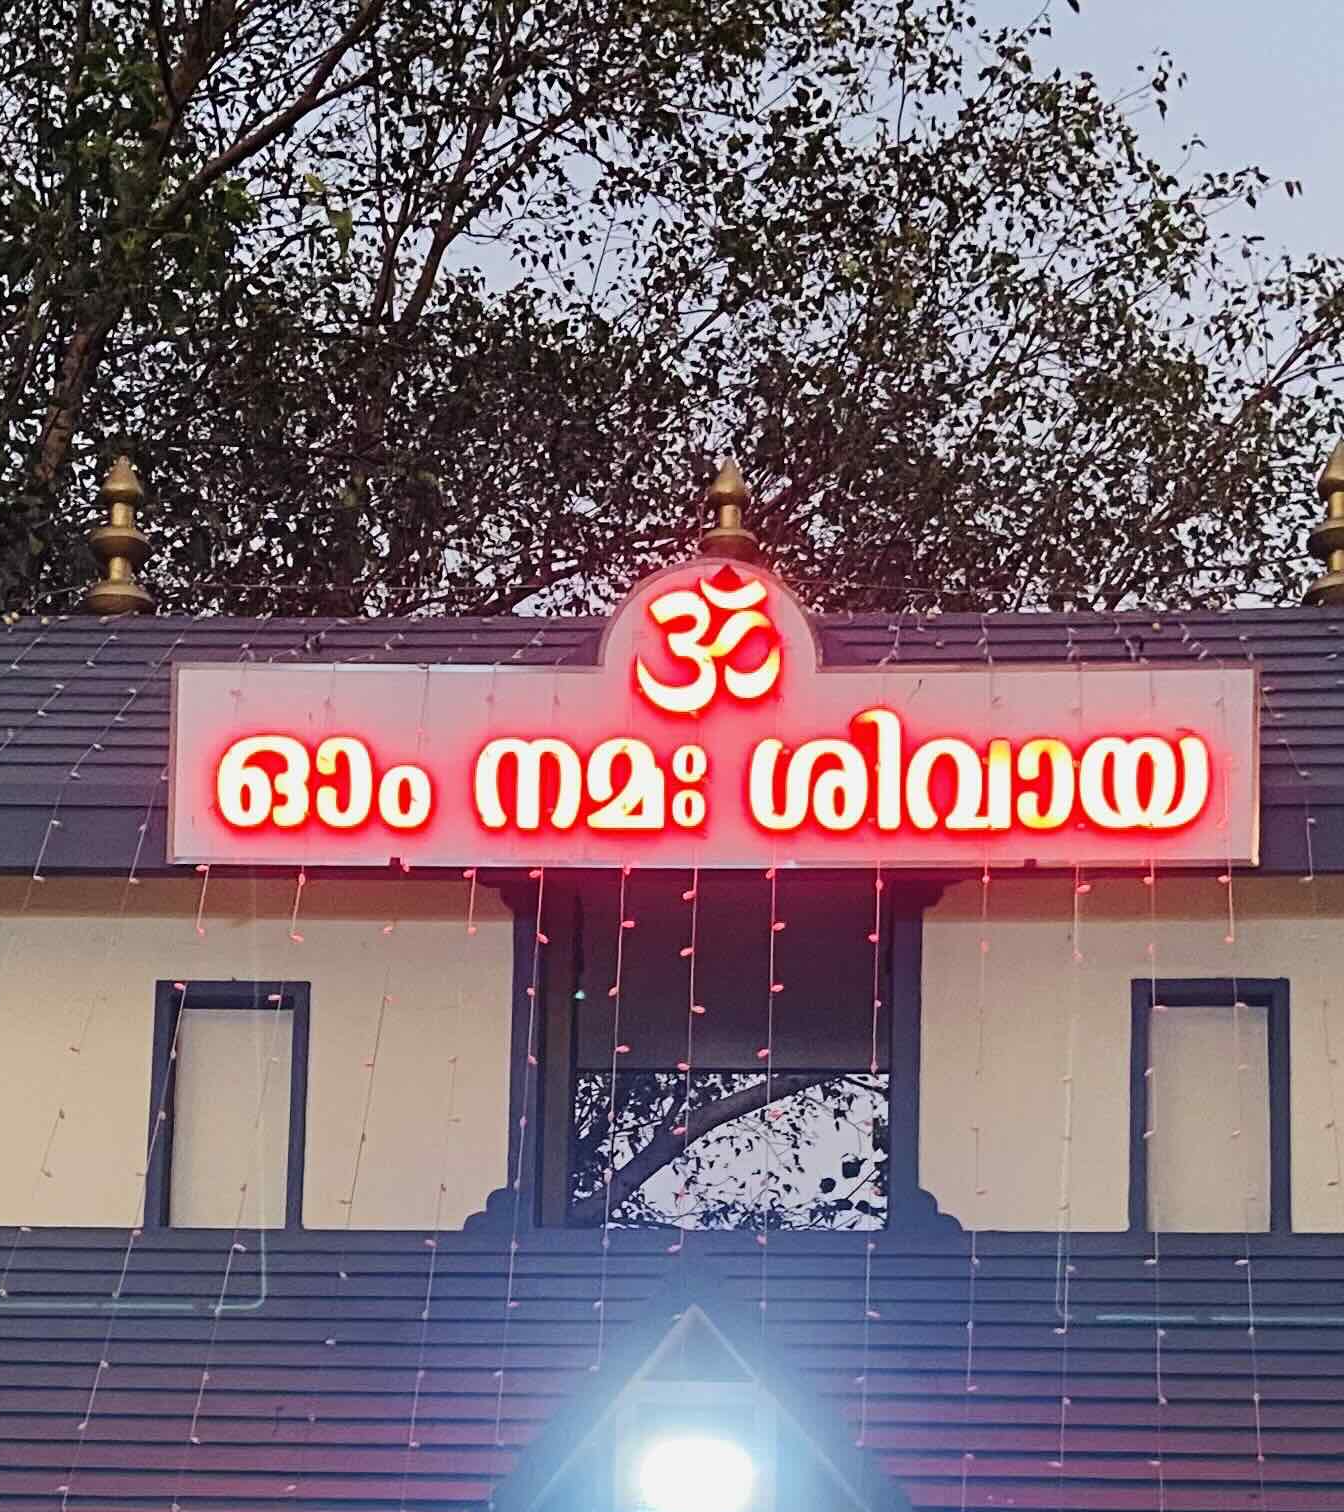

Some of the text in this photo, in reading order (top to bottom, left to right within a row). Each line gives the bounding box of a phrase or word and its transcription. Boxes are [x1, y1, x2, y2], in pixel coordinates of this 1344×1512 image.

[216, 707, 1210, 831] ഓം നമഃ ശിവായ
